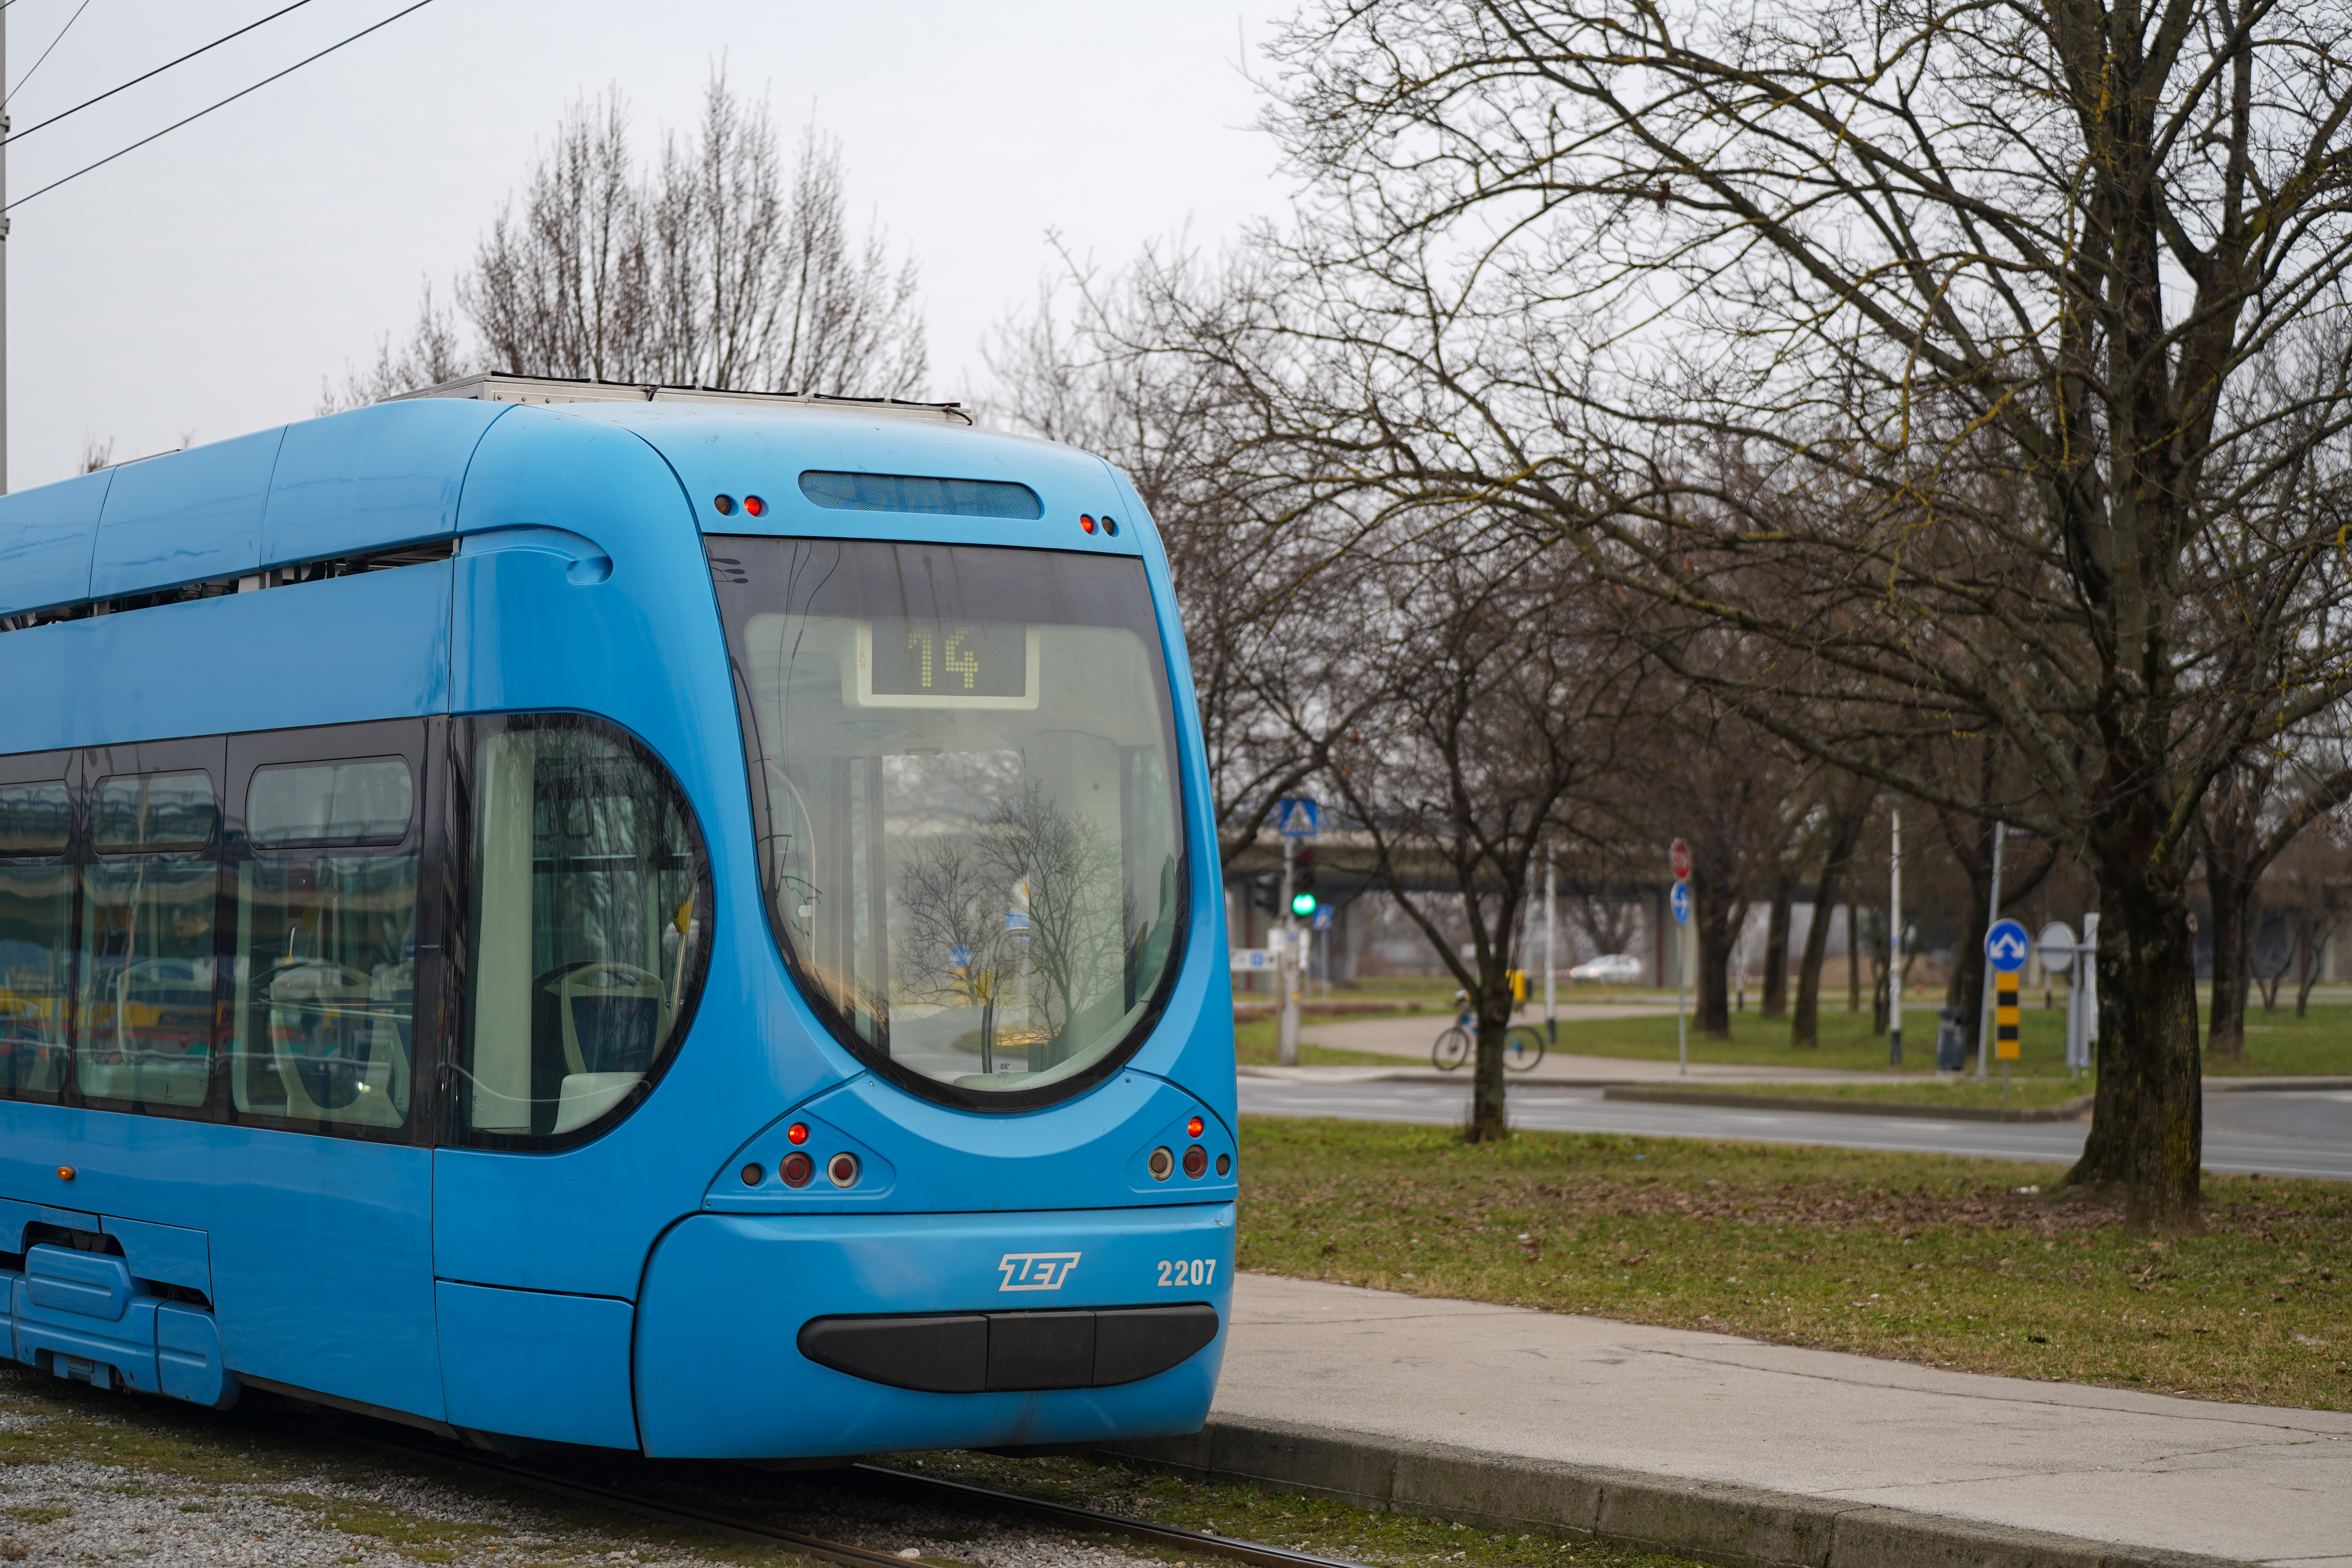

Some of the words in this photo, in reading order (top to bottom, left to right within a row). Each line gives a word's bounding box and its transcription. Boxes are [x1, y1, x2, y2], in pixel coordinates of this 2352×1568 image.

[908, 627, 978, 688] 14
[998, 1252, 1082, 1291] ZET
[1158, 1259, 1216, 1286] 2207
